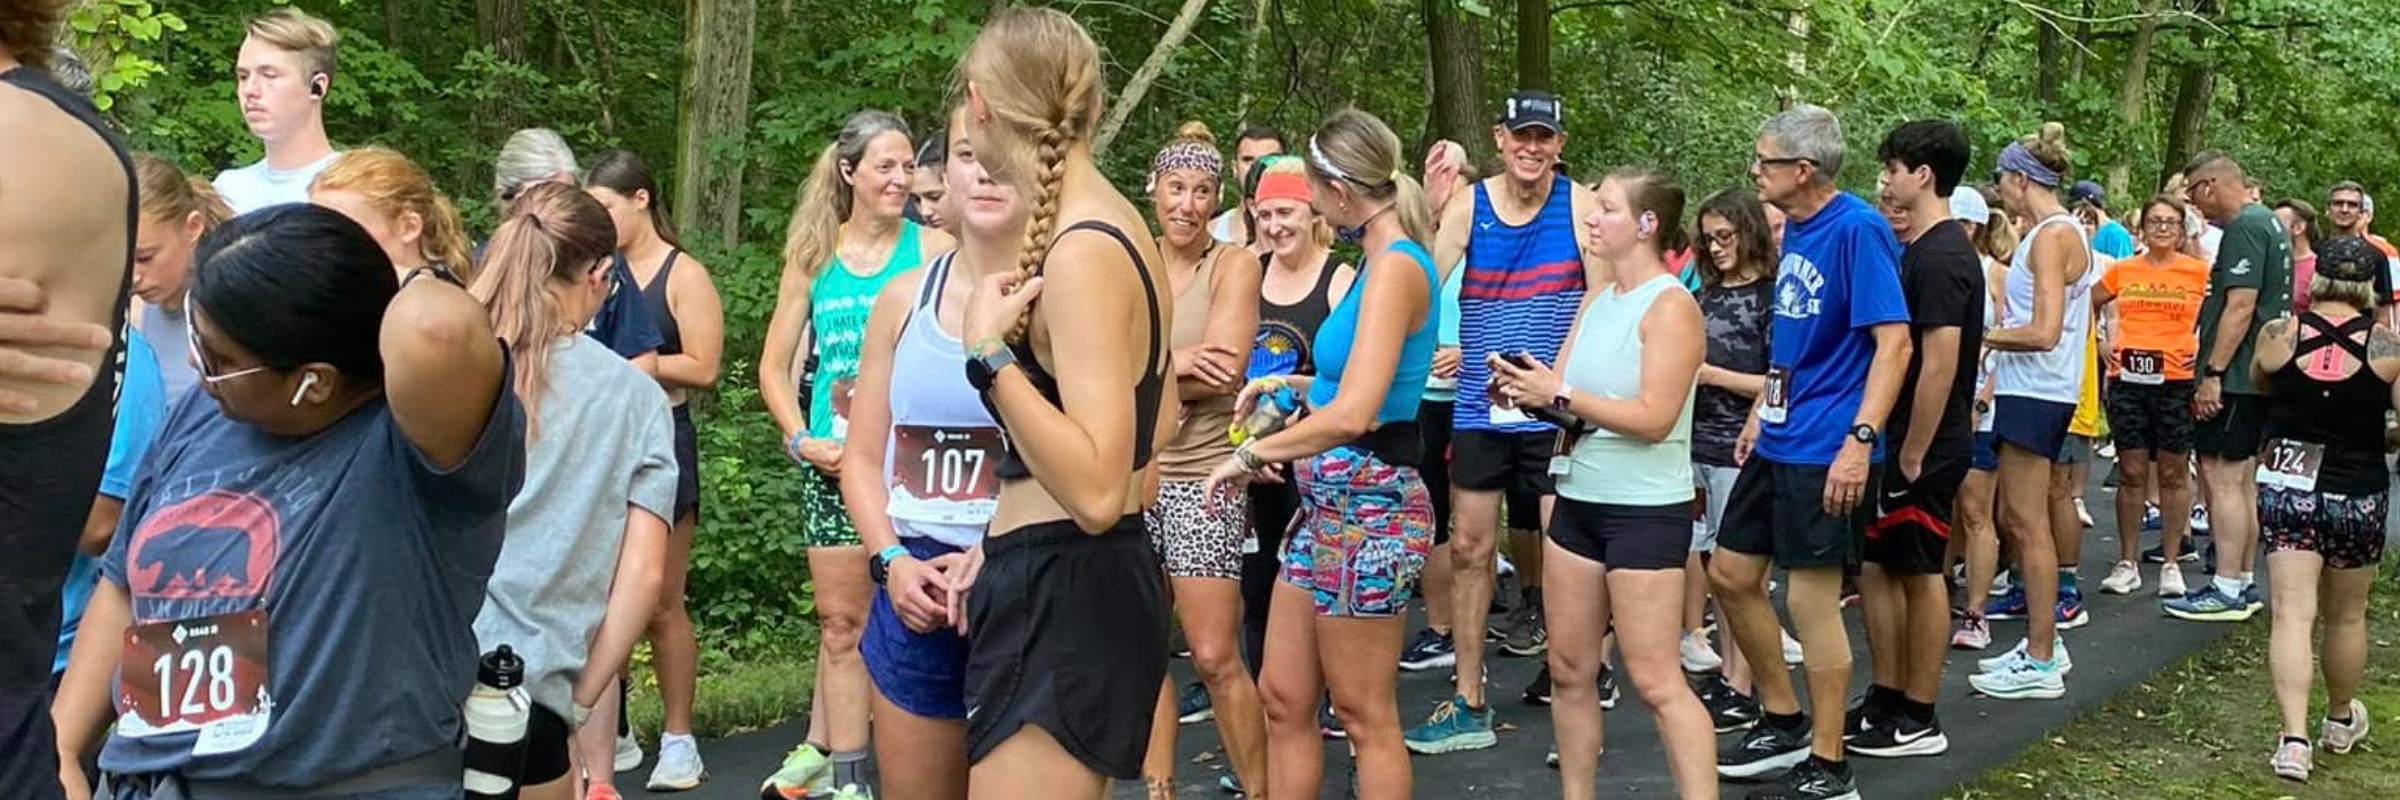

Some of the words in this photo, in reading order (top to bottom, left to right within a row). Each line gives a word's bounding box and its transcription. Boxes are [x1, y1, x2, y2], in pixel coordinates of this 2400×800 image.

[2129, 355, 2154, 374] 130
[921, 448, 985, 494] 107
[2272, 446, 2307, 473] 124
[153, 645, 236, 718] 128
